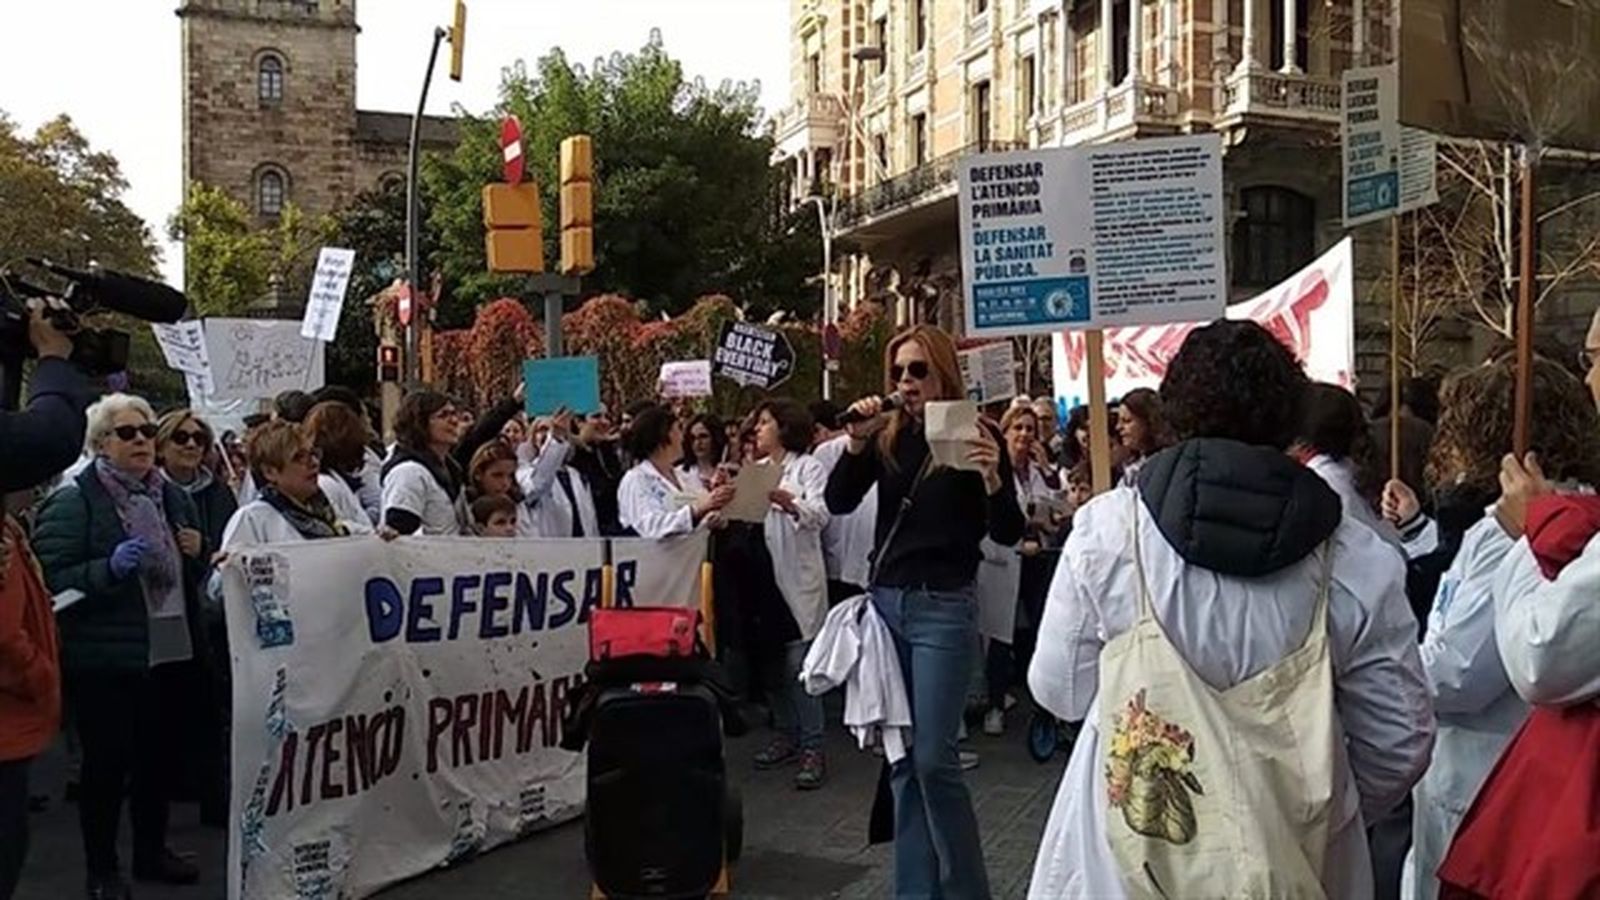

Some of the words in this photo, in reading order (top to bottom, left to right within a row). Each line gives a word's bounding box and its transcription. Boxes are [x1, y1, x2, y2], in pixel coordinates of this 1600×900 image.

[970, 162, 1044, 183] DEFENSAR
[973, 225, 1047, 246] DEFENSAR
[974, 248, 992, 264] LA
[995, 242, 1054, 262] SANITAT
[725, 331, 775, 360] BLACK
[715, 346, 780, 378] EVERYDAY
[364, 560, 637, 644] DEFENSAR
